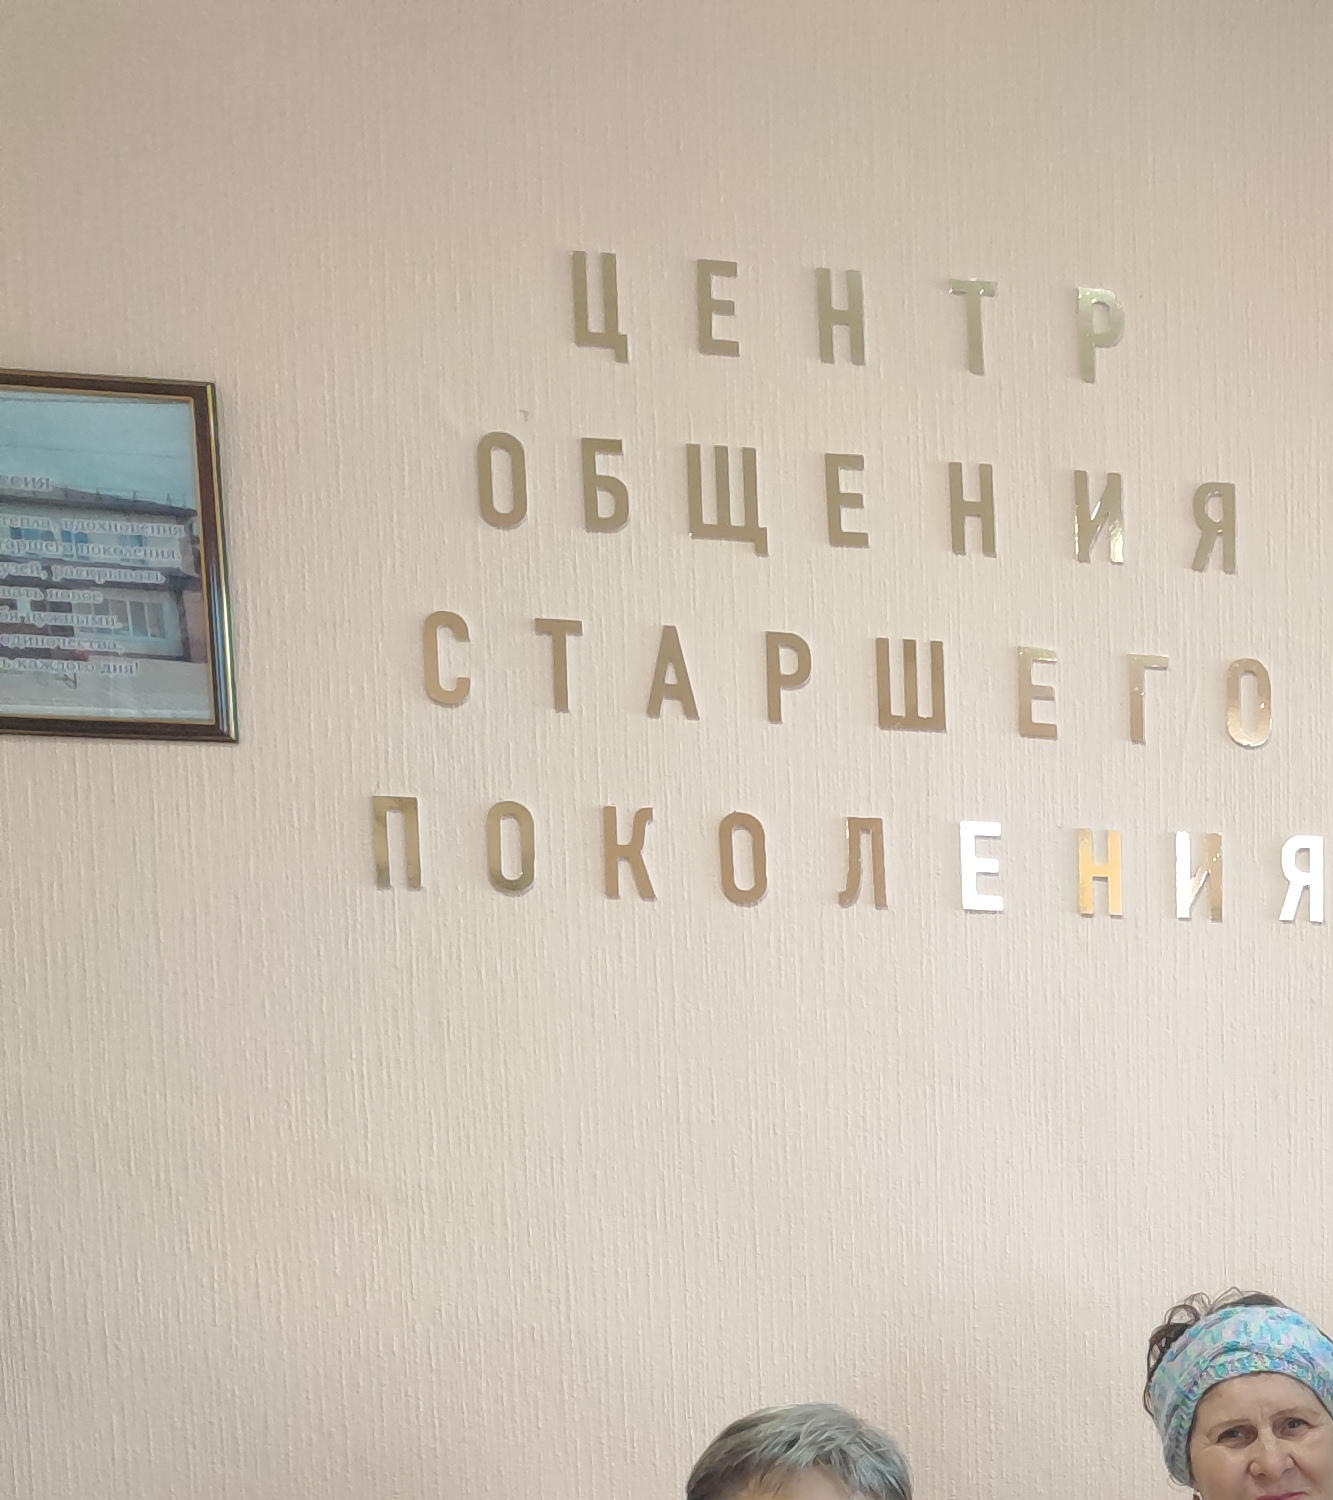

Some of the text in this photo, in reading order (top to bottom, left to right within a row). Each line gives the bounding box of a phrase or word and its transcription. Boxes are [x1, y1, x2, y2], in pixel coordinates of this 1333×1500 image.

[571, 250, 1126, 384] ЦЕНТР
[476, 431, 1238, 575] ОБЩЕНИЯ
[18, 659, 95, 674] каждого
[100, 662, 139, 675] дня!
[422, 610, 1274, 749] СТАРШЕГО
[371, 795, 1326, 924] ПОКОЛЕНИЯ
